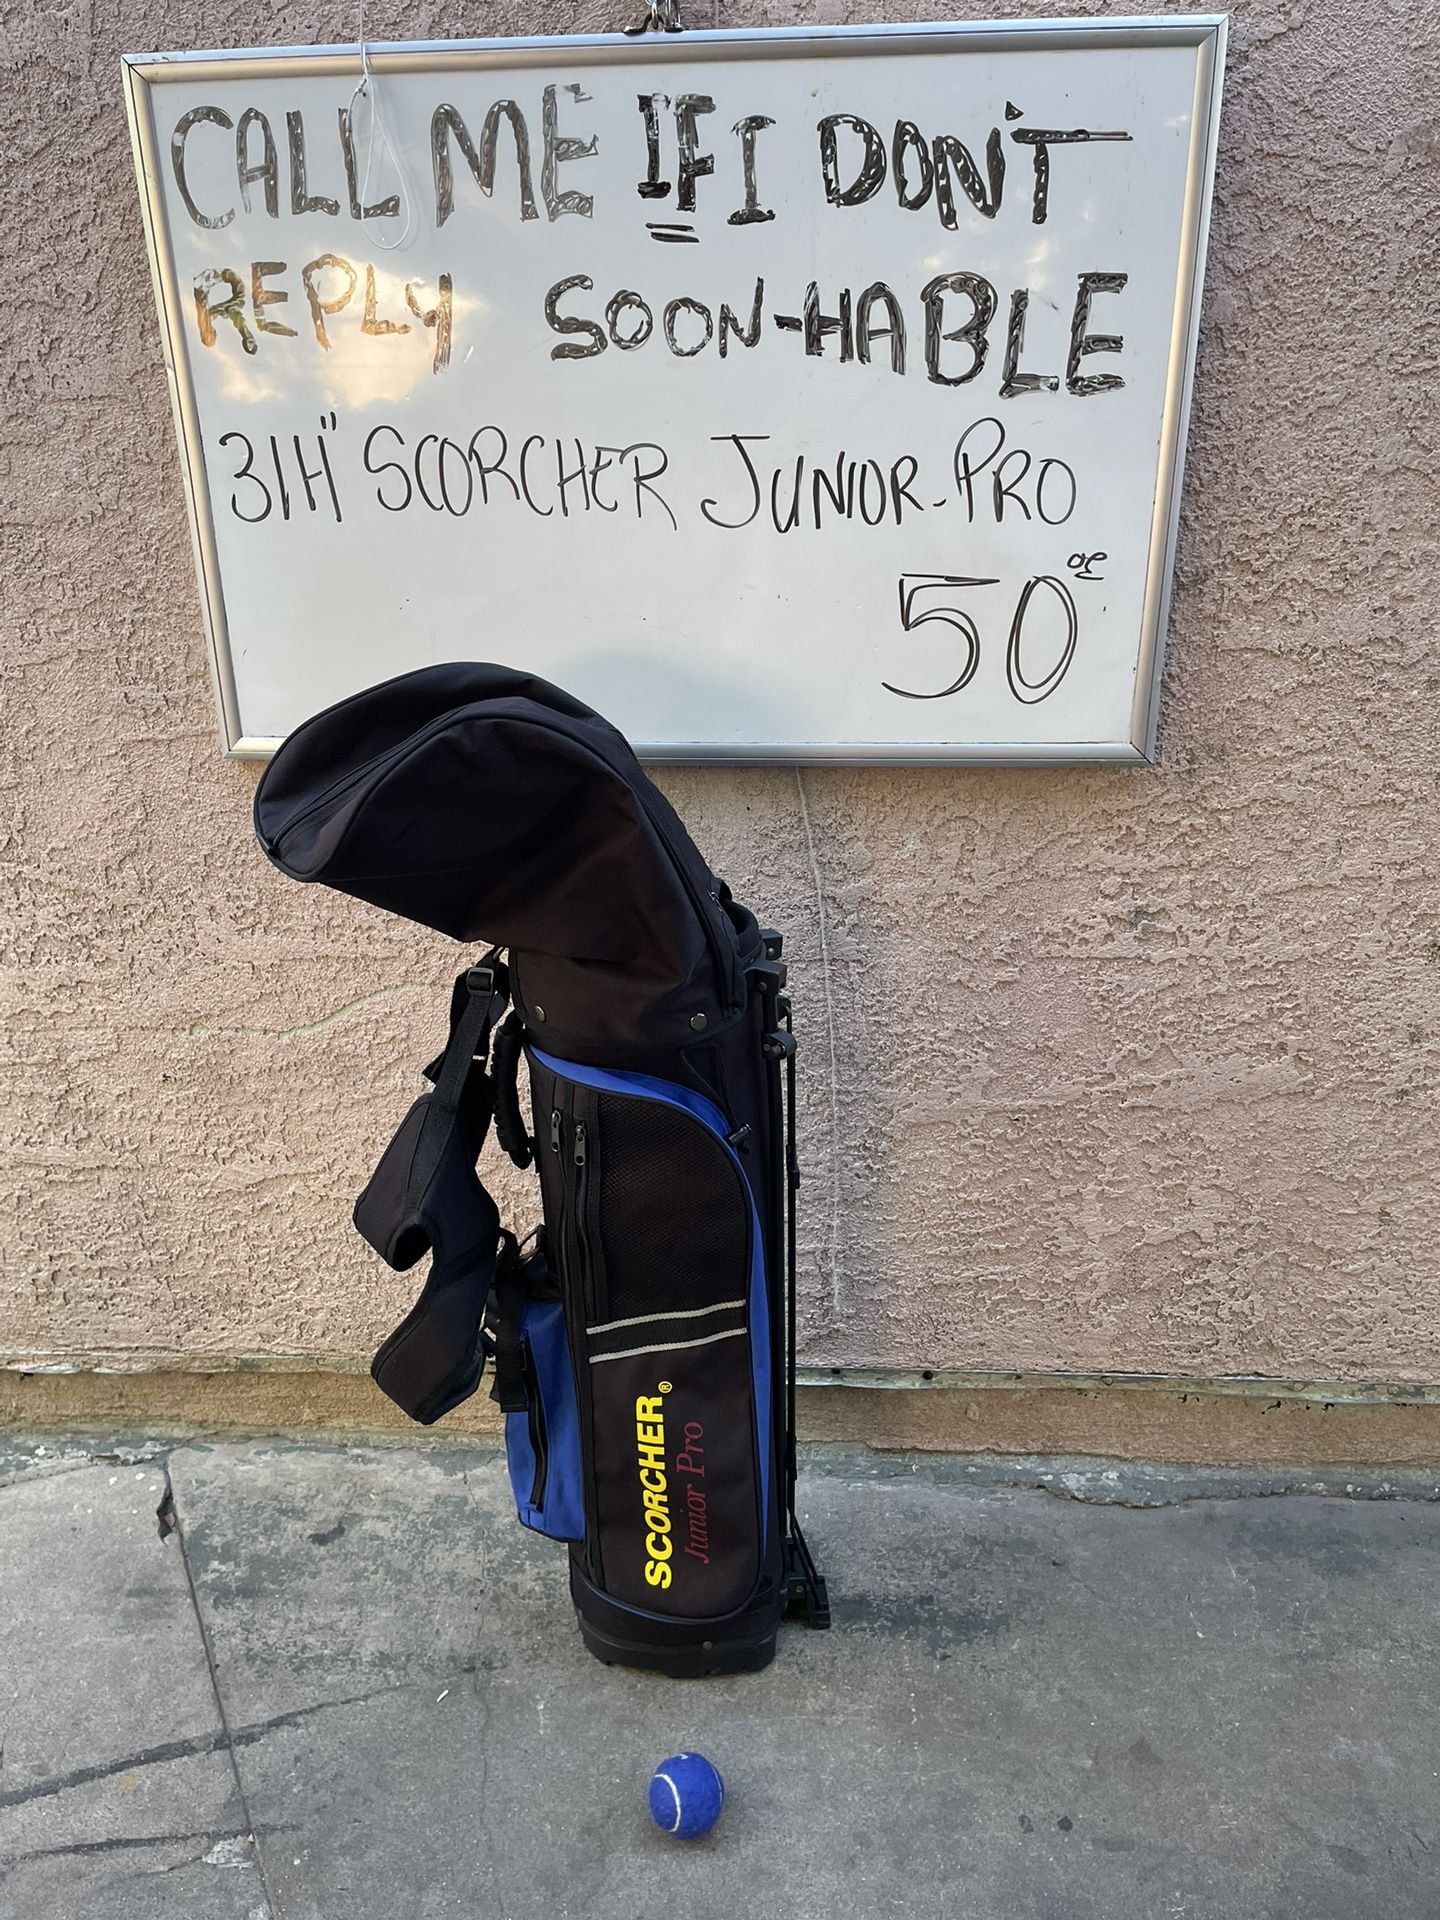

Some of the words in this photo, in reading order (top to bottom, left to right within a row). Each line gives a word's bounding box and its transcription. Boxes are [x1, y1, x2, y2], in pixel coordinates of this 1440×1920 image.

[171, 104, 402, 230] CALL
[429, 83, 600, 229] ME
[636, 92, 717, 214] IF
[726, 114, 777, 226] I
[816, 100, 1134, 232] DON'T
[193, 253, 453, 376] REPLY
[362, 424, 678, 531] SCORCHER
[676, 1421, 705, 1478] Pro
[684, 1484, 710, 1564] Junior
